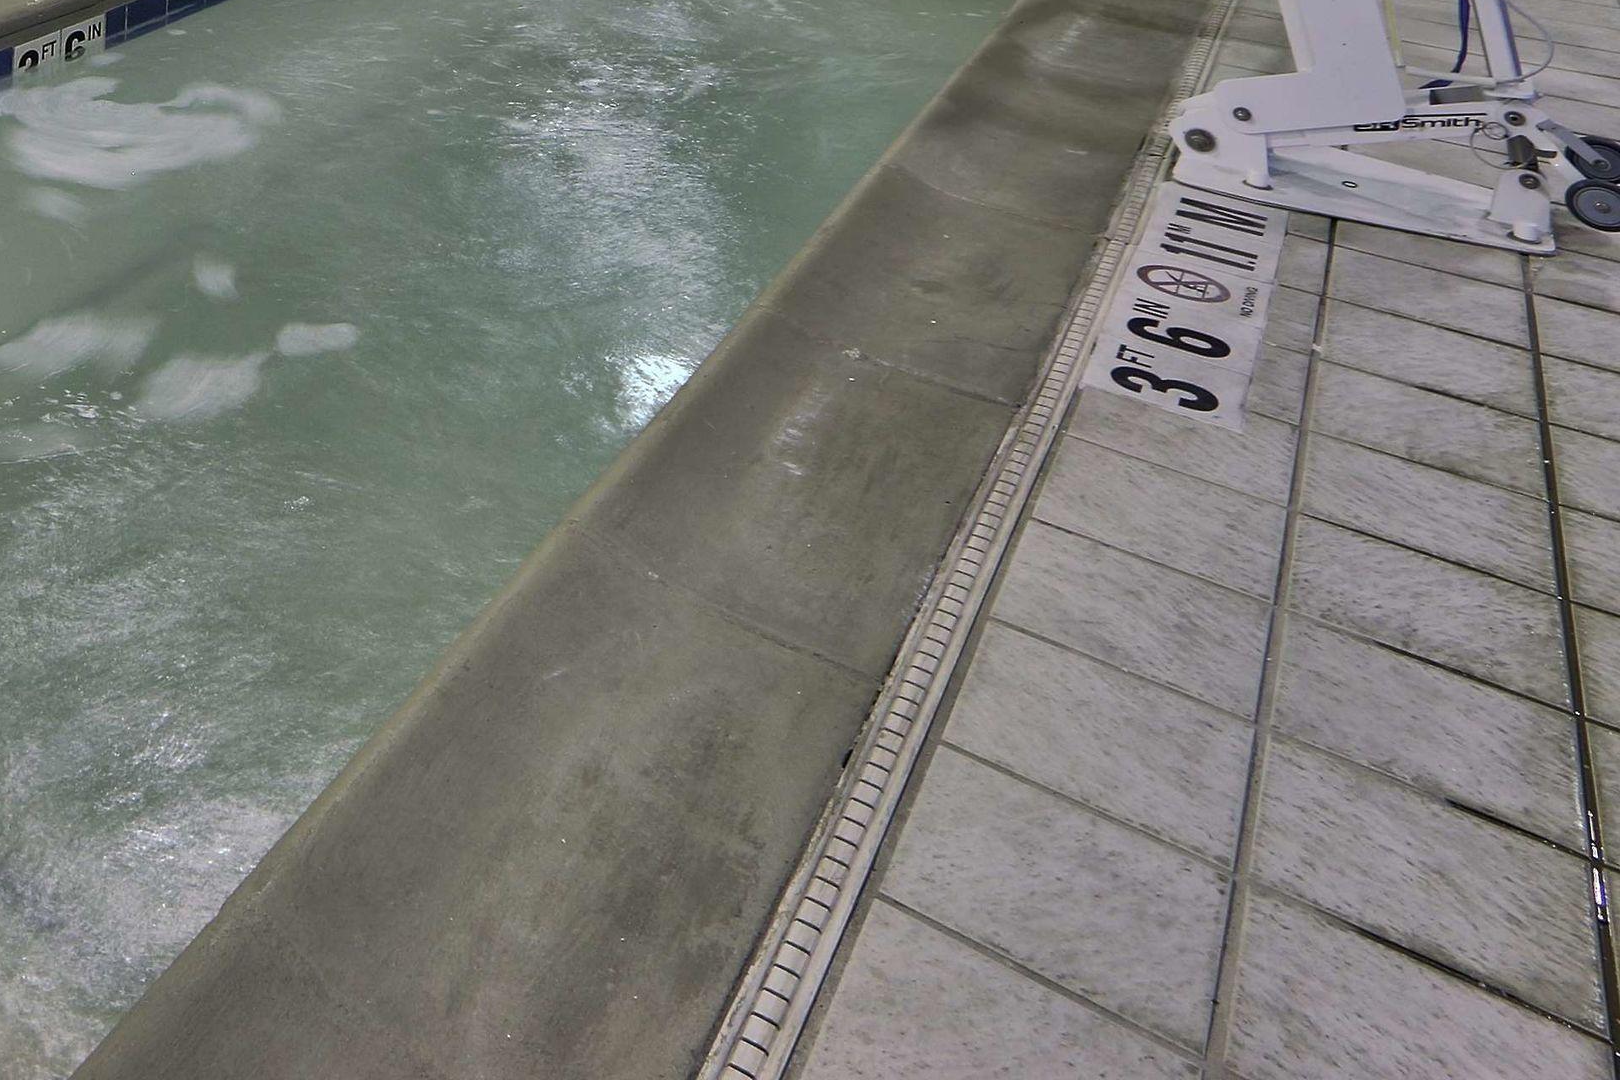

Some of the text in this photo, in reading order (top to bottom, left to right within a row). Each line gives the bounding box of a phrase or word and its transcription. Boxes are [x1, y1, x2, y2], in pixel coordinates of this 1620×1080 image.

[42, 40, 57, 60] FT
[88, 22, 102, 41] IN
[1176, 197, 1268, 236] M
[1133, 297, 1171, 319] IN
[1239, 286, 1258, 318] NO DIVING
[1116, 344, 1155, 368] FT
[1127, 317, 1231, 358] 6
[1111, 367, 1219, 412] 3
